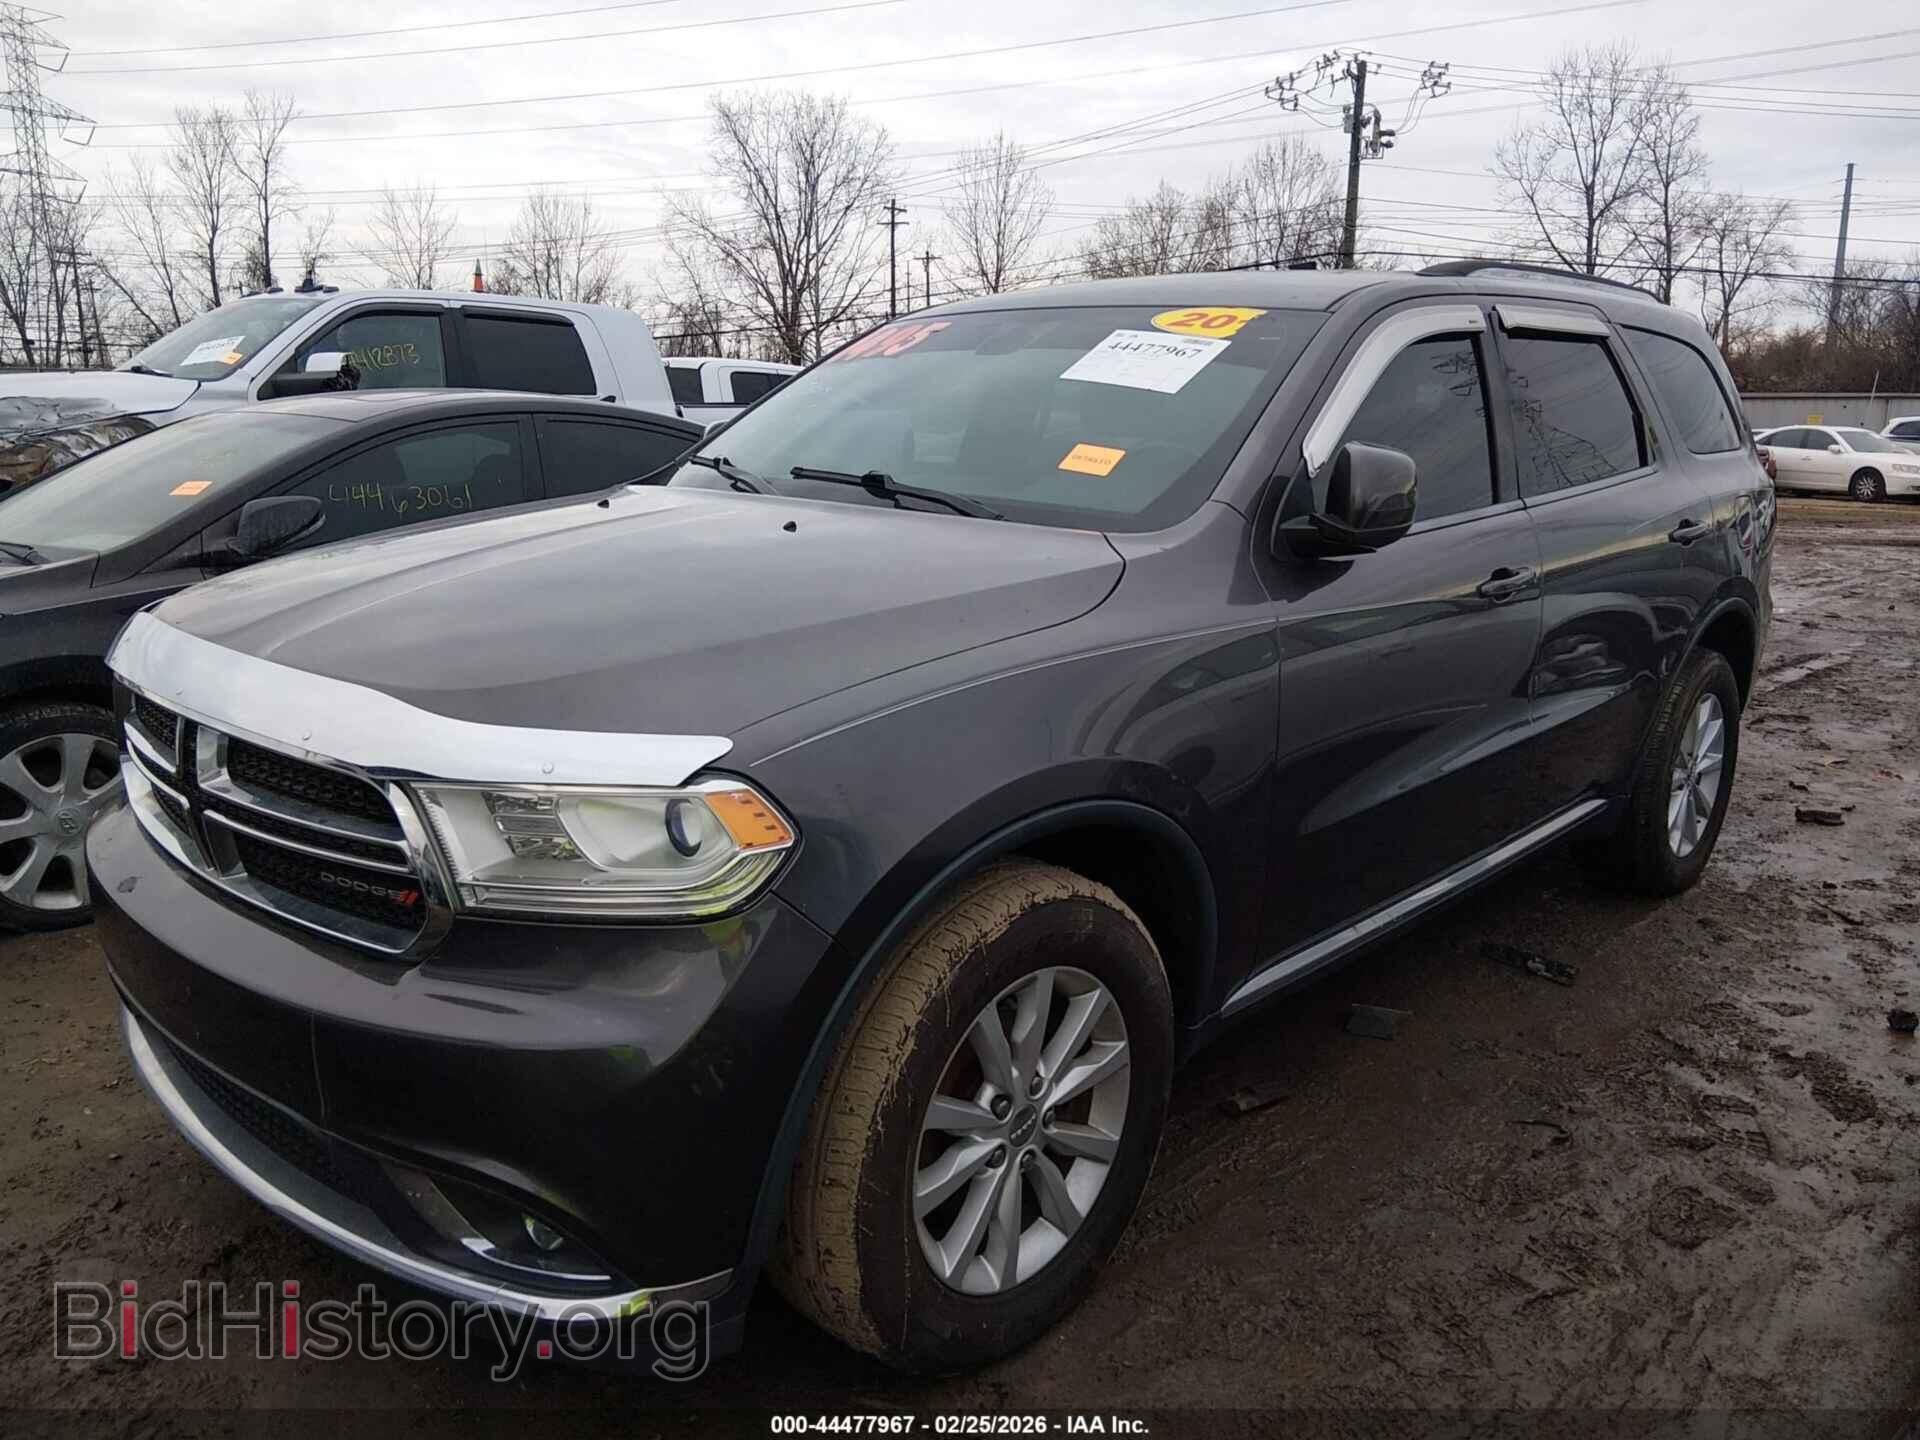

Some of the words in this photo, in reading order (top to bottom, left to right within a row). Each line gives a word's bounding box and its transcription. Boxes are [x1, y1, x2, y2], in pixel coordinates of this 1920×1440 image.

[1165, 311, 1249, 330] 20
[1107, 341, 1202, 359] 44477967
[320, 871, 402, 899] DODGE
